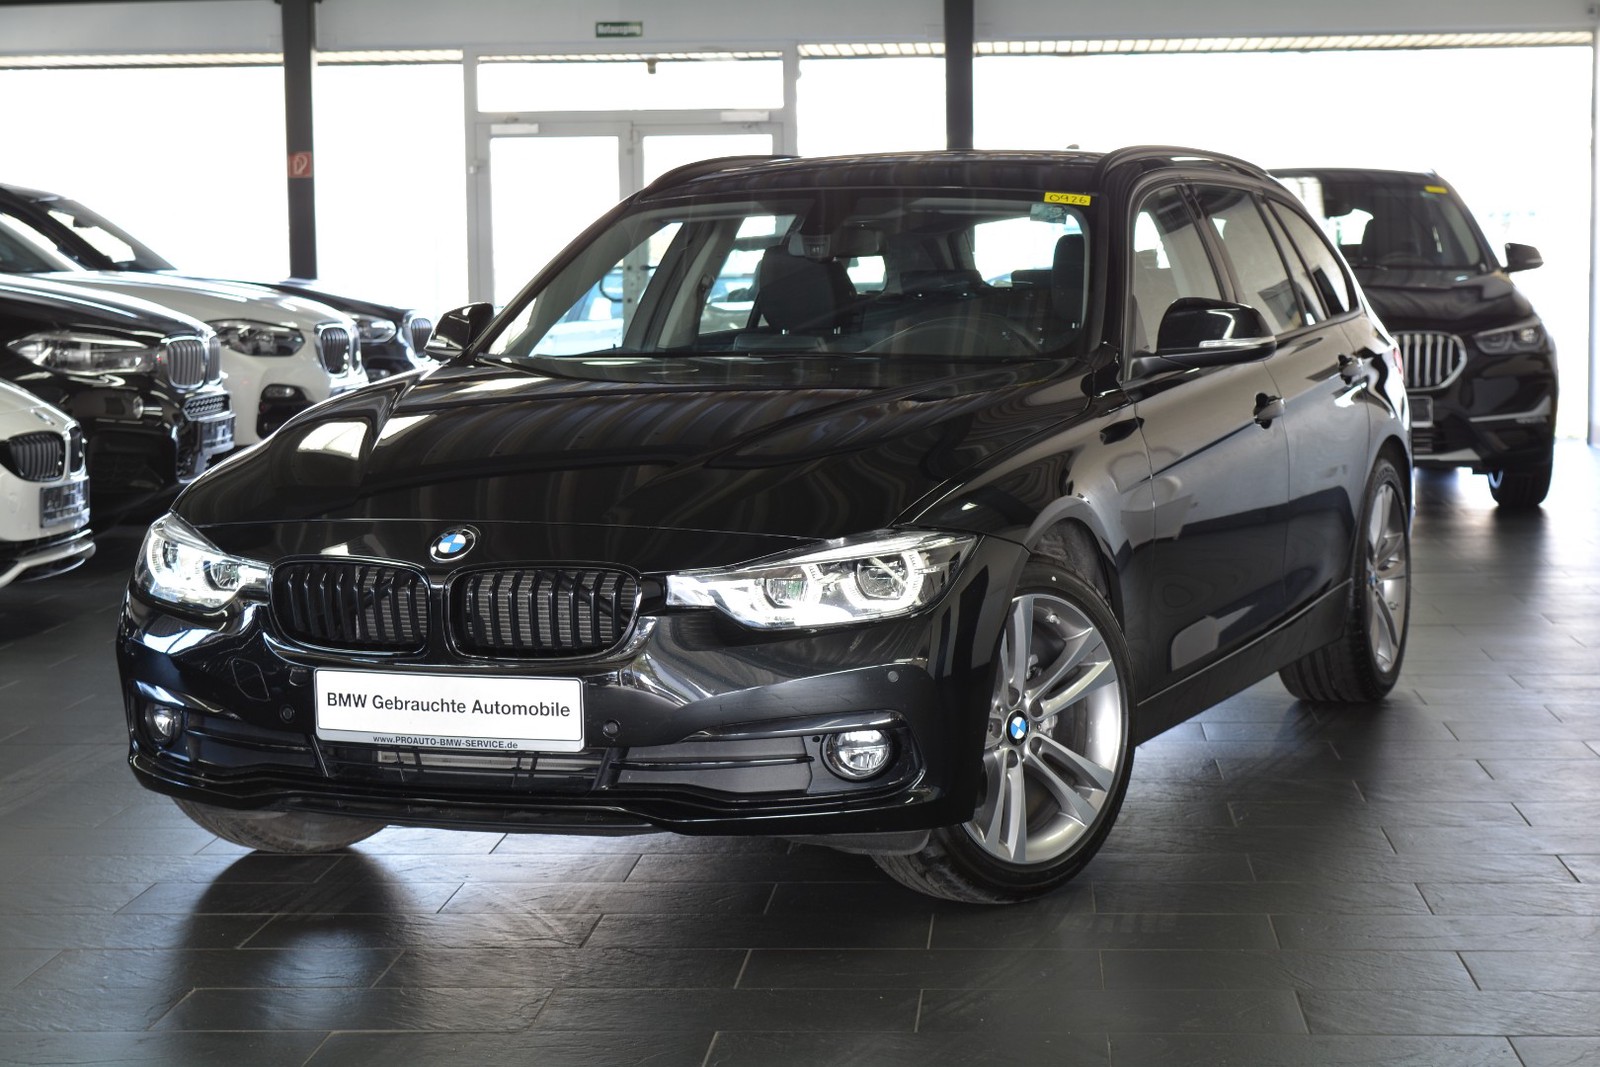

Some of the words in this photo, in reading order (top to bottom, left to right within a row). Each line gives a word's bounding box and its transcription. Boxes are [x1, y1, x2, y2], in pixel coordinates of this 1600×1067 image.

[327, 692, 367, 708] BMW
[372, 695, 467, 713] Gebrauchte
[471, 700, 570, 716] Automobile
[372, 735, 518, 749] www.PROAUTO-BMW-SERVICE.de
